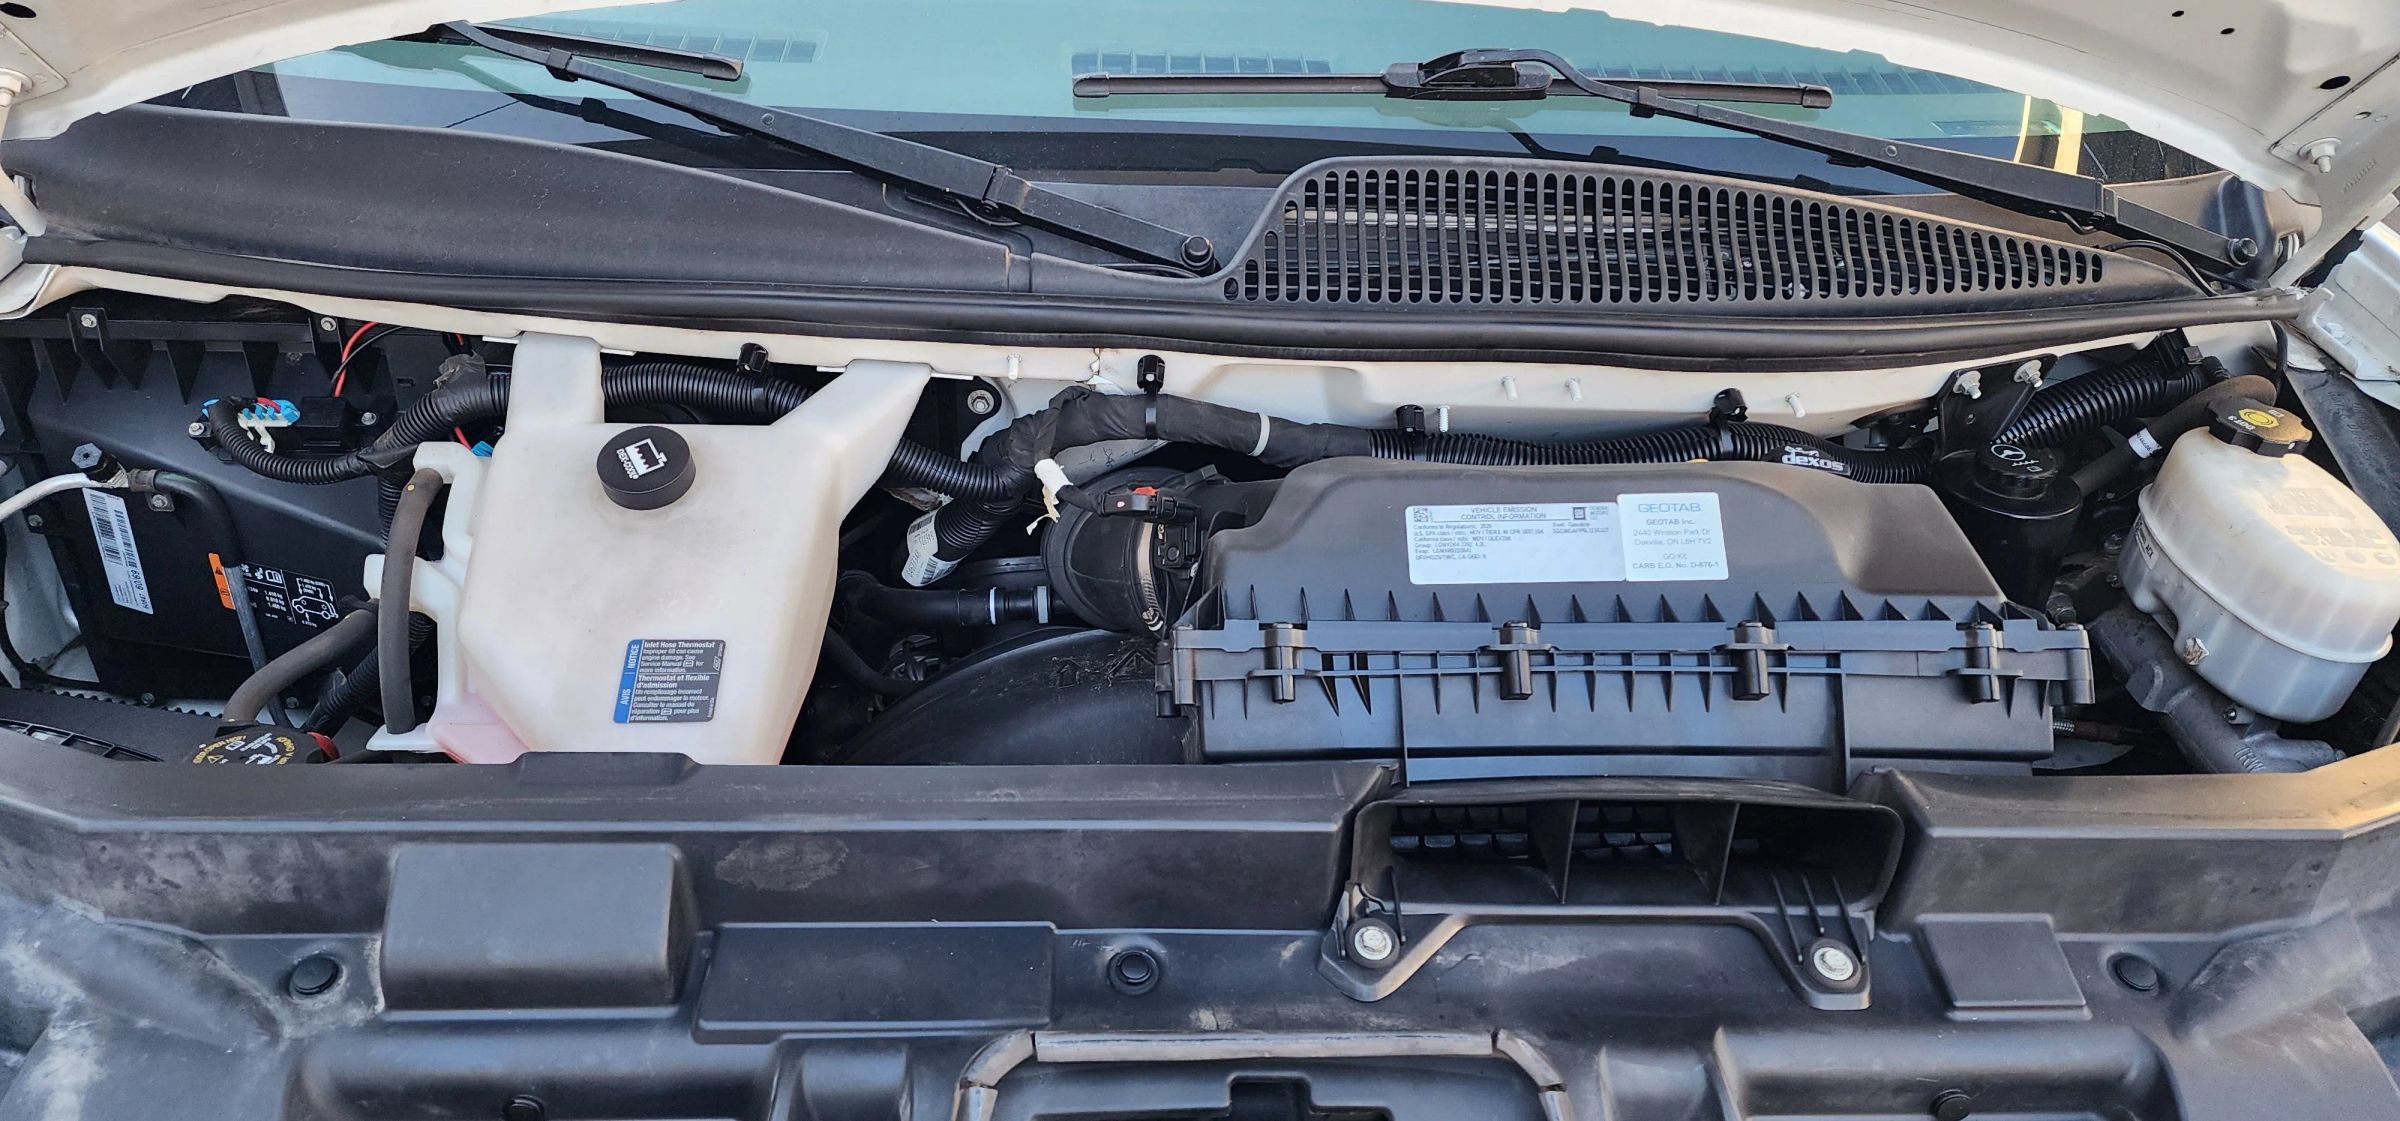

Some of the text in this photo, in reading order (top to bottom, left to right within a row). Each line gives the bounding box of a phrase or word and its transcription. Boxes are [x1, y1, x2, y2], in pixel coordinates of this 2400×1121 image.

[1782, 446, 1844, 471] dexos
[1638, 502, 1702, 513] GEOTAB
[627, 644, 640, 669] NOTICE
[620, 688, 632, 705] AVIS
